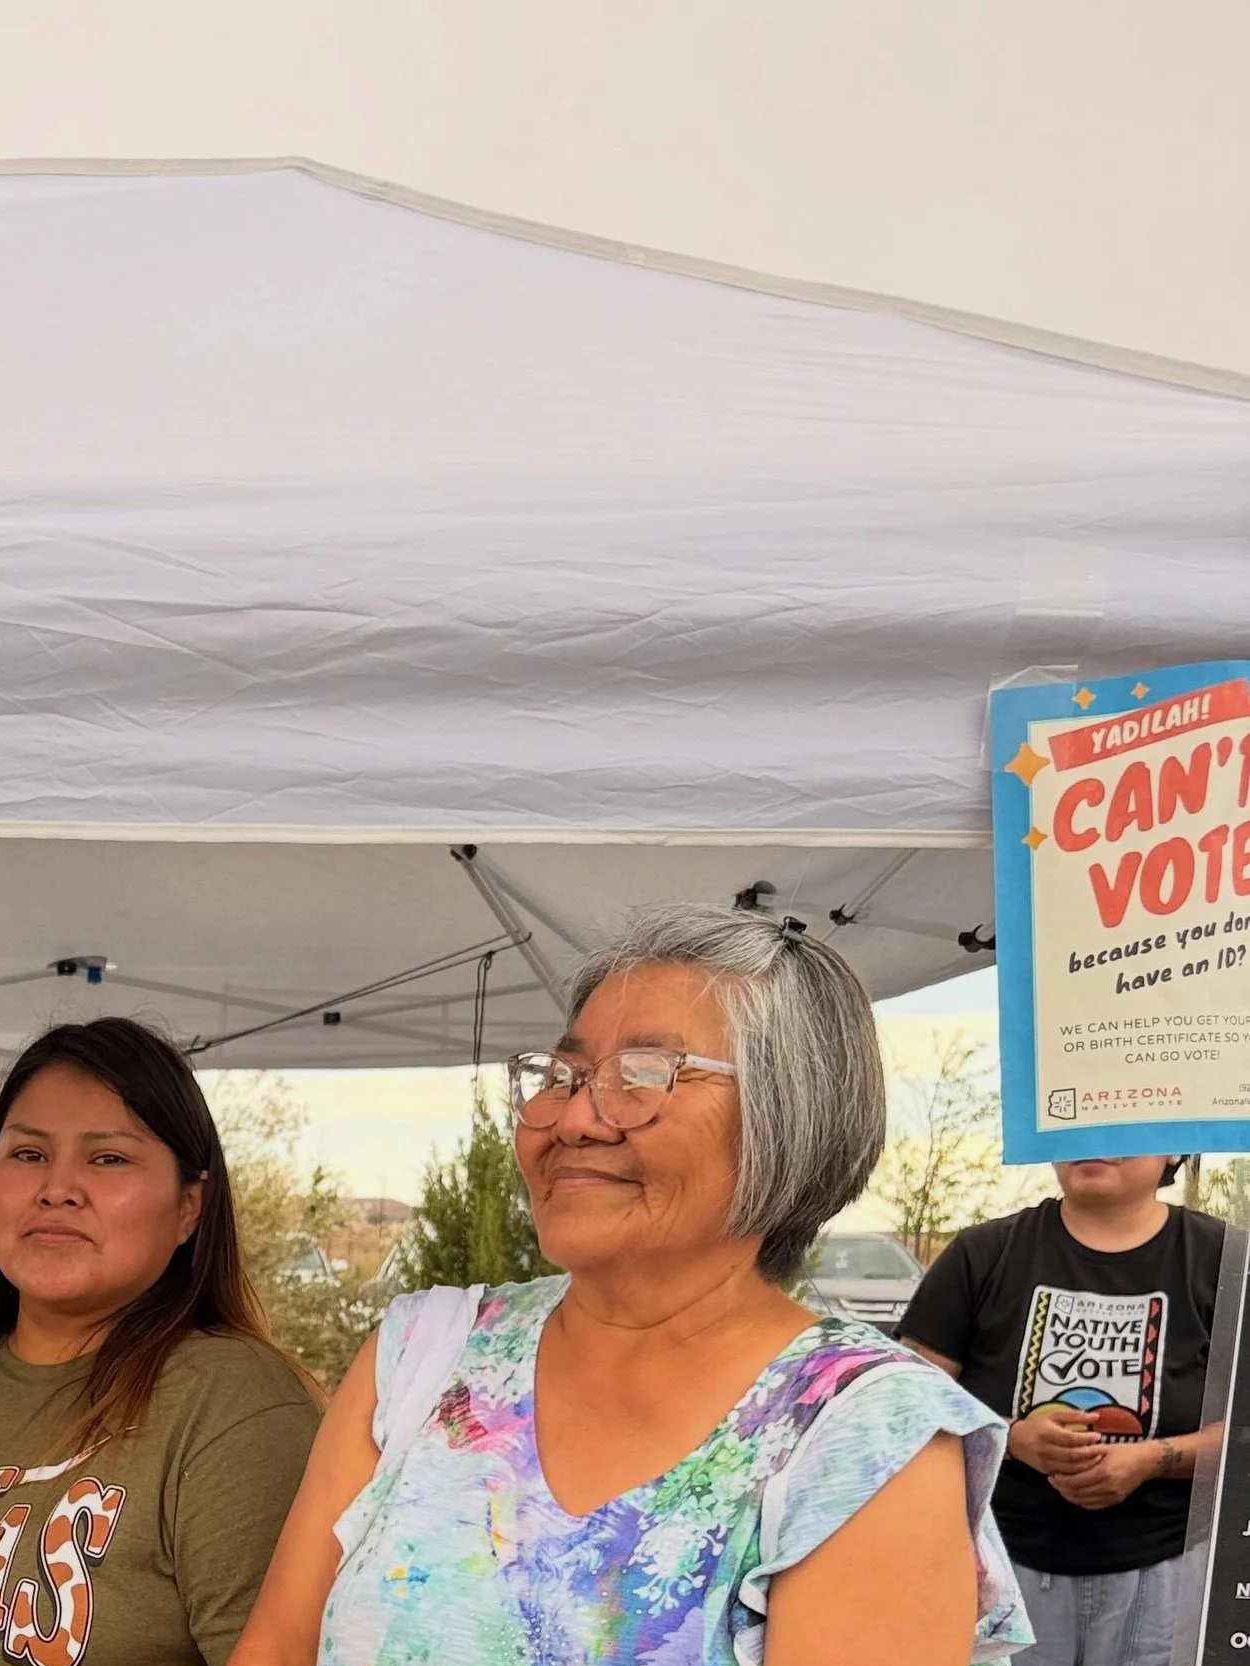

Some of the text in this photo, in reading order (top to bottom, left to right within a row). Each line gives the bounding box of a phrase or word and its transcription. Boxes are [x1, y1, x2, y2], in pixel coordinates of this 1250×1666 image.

[1091, 693, 1212, 755] YADILAH!
[1068, 934, 1167, 974] because
[1176, 921, 1217, 950] you
[1115, 944, 1247, 995] have an ID?
[1060, 1025, 1083, 1036] WE
[1087, 1021, 1119, 1033] CAN
[1123, 1016, 1160, 1030] HELP
[1164, 1015, 1193, 1027] YOU
[1196, 1014, 1220, 1026] GET
[1063, 1041, 1085, 1053] OR
[1089, 1037, 1133, 1050] BIRTH
[1137, 1032, 1221, 1046] CERTIFICATE
[1224, 1032, 1240, 1042] SO
[1124, 1049, 1222, 1064] CAN GO VOTE!
[1081, 1086, 1183, 1102] ARIZONA
[1081, 1099, 1183, 1111] NATIVE VOTE
[1077, 1300, 1146, 1312] ARIZONA
[1050, 1313, 1143, 1336] NATIVE
[1050, 1331, 1141, 1354] YOUTH
[1230, 1632, 1250, 1649] O
